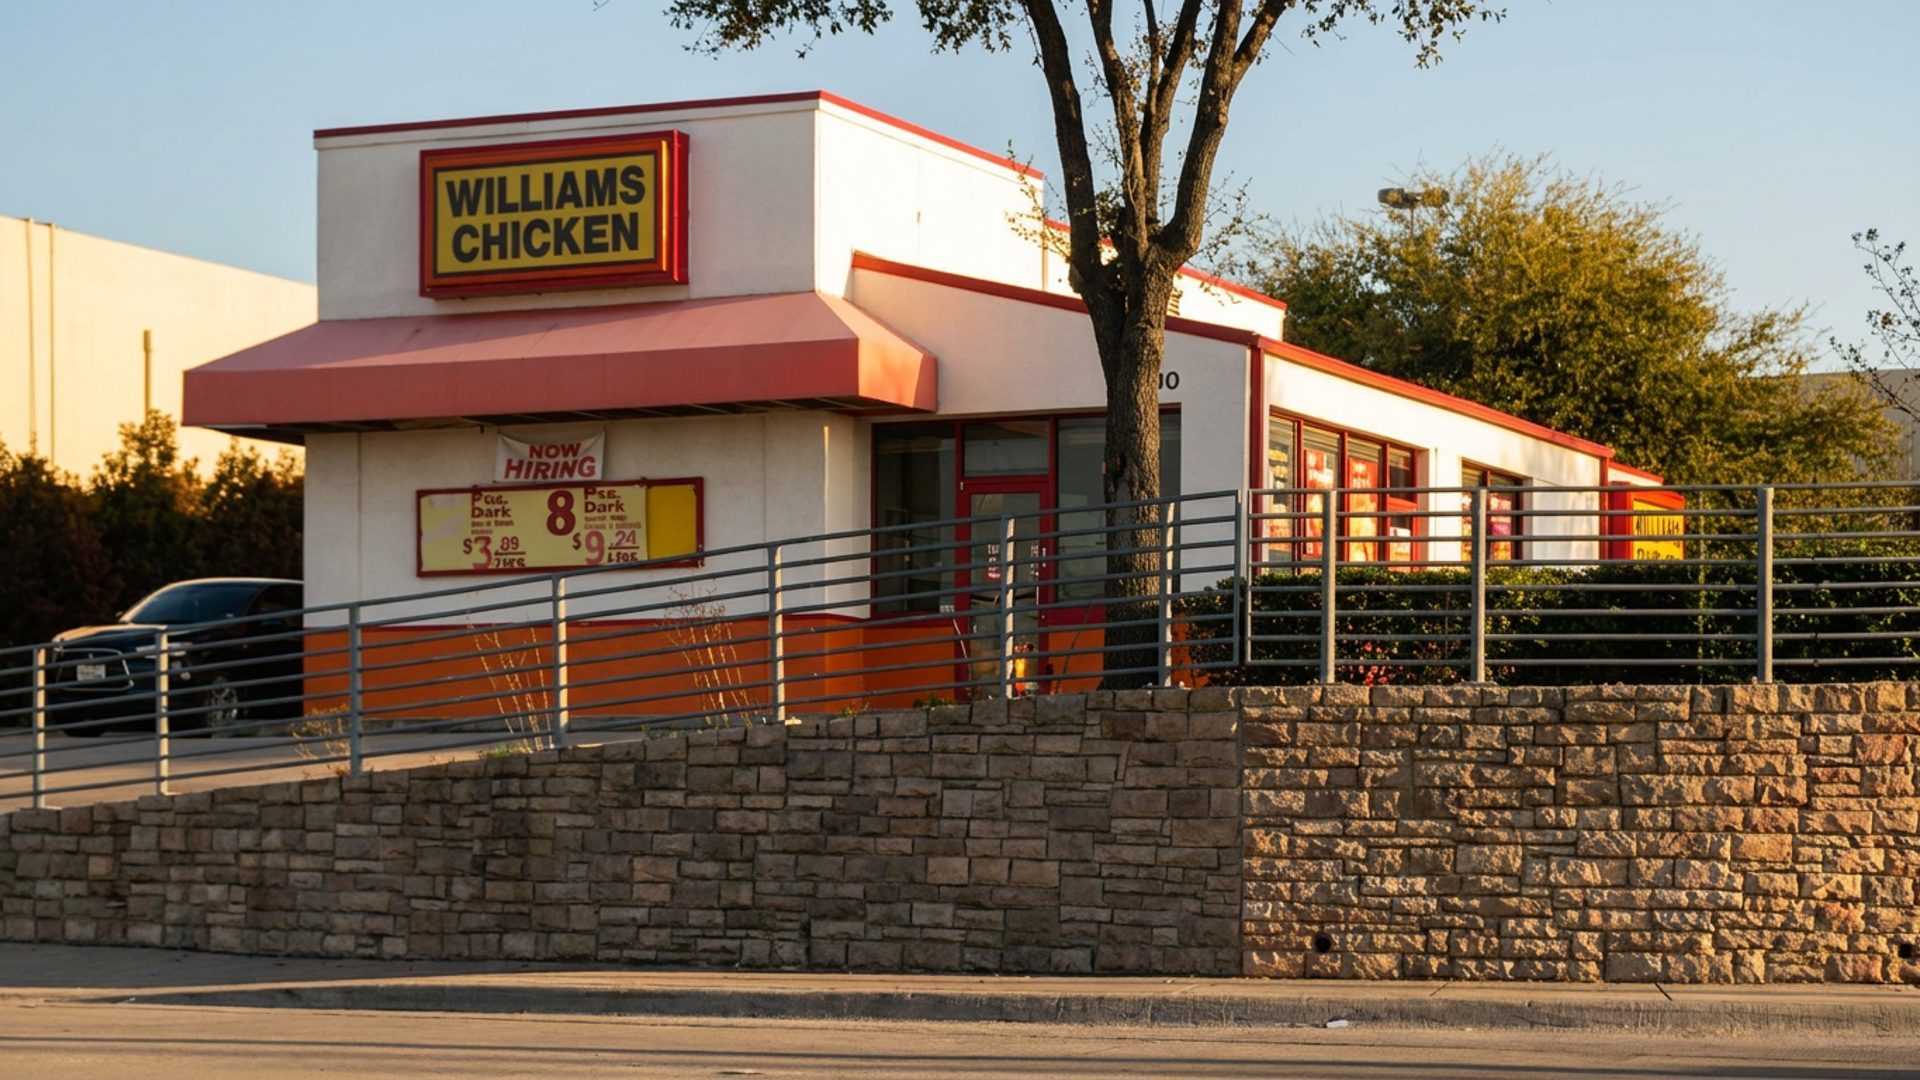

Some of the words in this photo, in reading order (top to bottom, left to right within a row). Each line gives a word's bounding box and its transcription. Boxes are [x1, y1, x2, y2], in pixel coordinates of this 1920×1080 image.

[446, 165, 646, 217] WILLIAMS
[452, 212, 639, 263] CHICKEN
[529, 443, 581, 459] NOW
[504, 456, 596, 480] HIRING
[471, 506, 511, 519] Dark
[547, 490, 577, 536] 8
[584, 500, 625, 513] Dark
